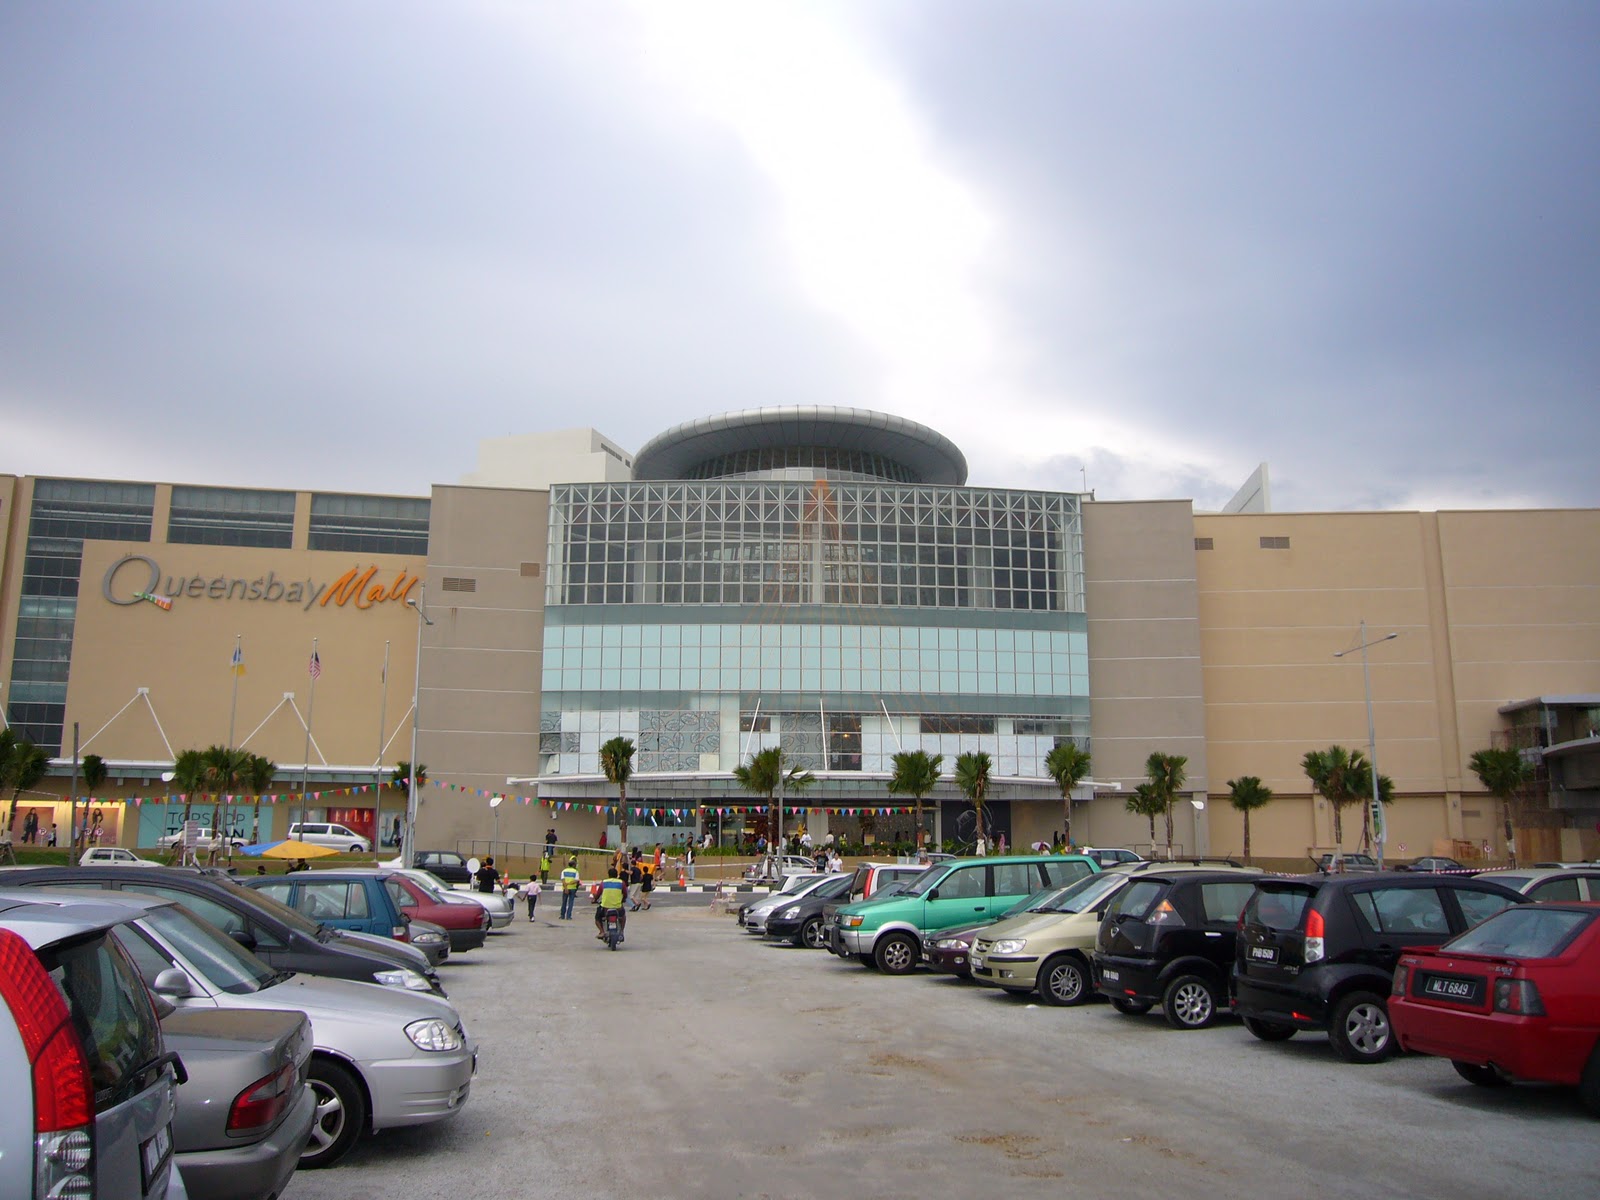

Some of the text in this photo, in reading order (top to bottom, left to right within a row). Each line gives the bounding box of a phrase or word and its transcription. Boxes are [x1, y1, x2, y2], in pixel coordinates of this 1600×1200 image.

[102, 555, 419, 611] Queensbay Mall
[335, 809, 370, 822] ELLE
[1448, 982, 1469, 995] 6849
